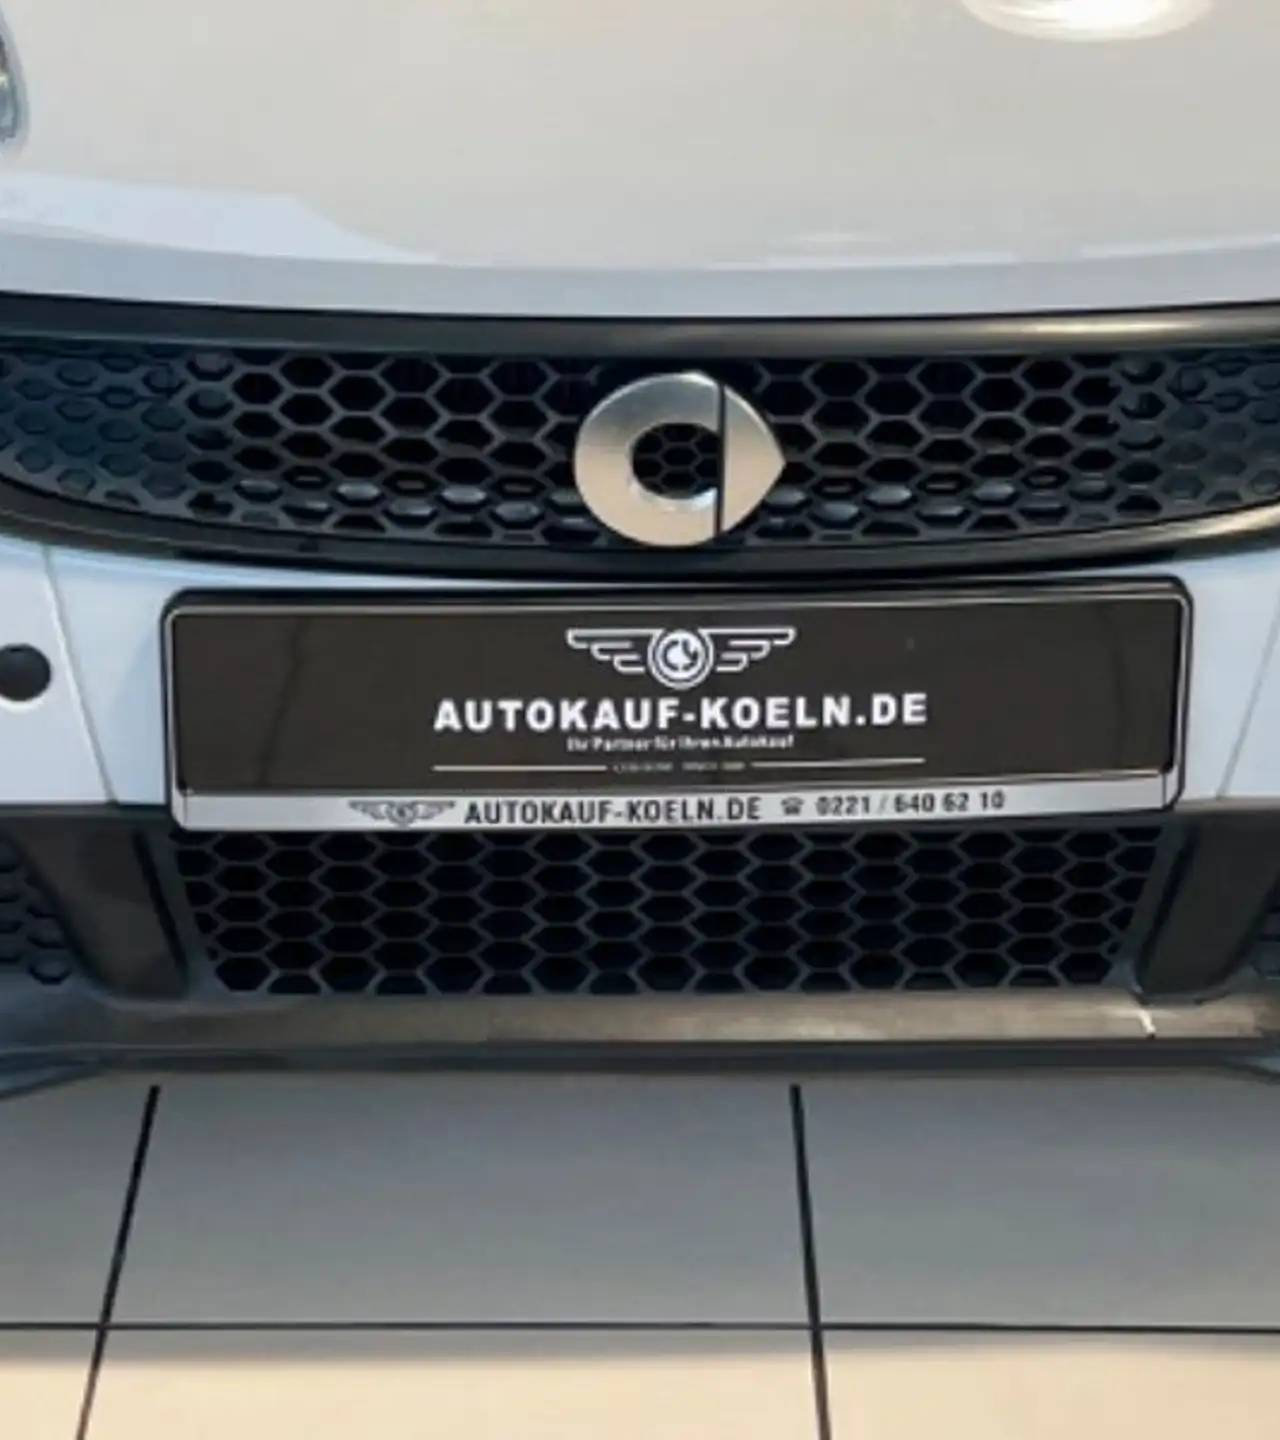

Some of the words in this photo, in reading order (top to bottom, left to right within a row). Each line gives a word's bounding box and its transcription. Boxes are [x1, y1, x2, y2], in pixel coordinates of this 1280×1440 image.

[433, 692, 928, 732] AUTOKAUF-KOELN.DE
[464, 796, 762, 825] AUTOKAUF-KOELN.DE
[816, 795, 870, 817] 0221
[981, 788, 1006, 810] 10
